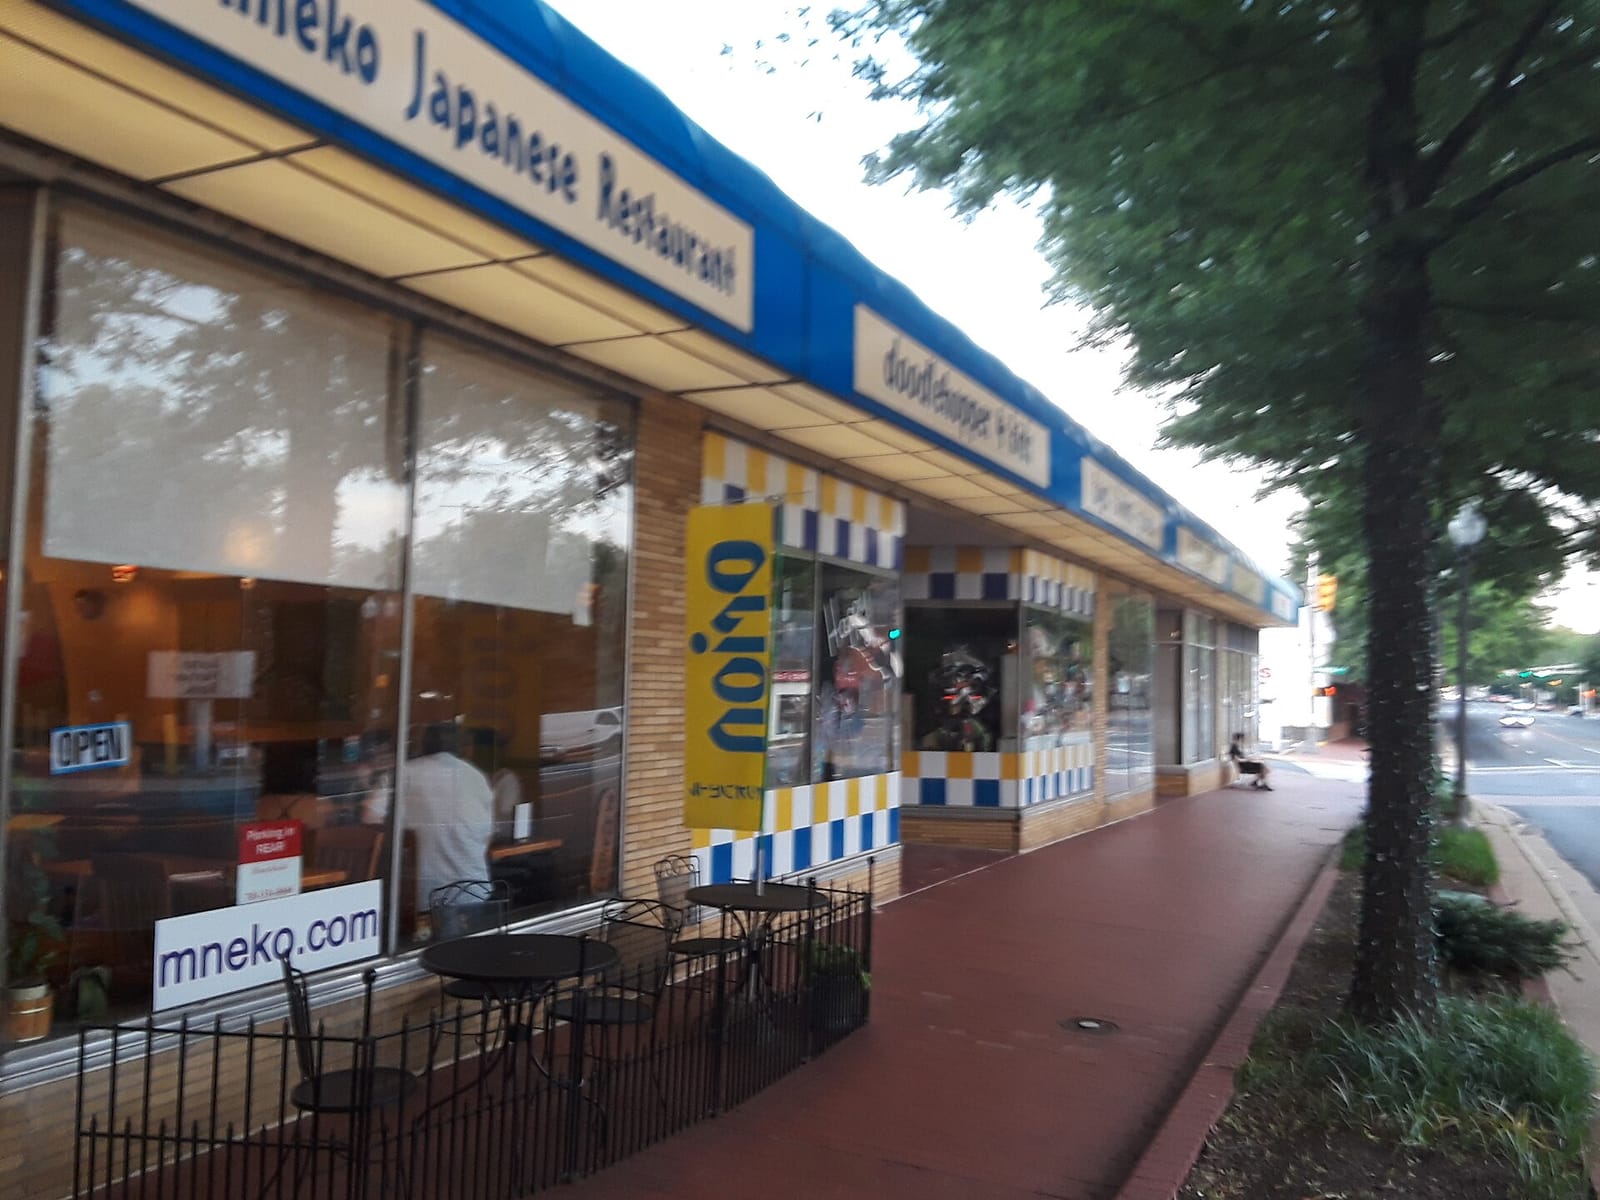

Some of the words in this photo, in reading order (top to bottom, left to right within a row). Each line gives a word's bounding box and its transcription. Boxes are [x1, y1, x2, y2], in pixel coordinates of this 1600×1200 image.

[405, 31, 578, 203] Japanese
[598, 152, 735, 296] Restaurant
[57, 728, 122, 766] OPEN
[158, 908, 378, 988] mneko.com
